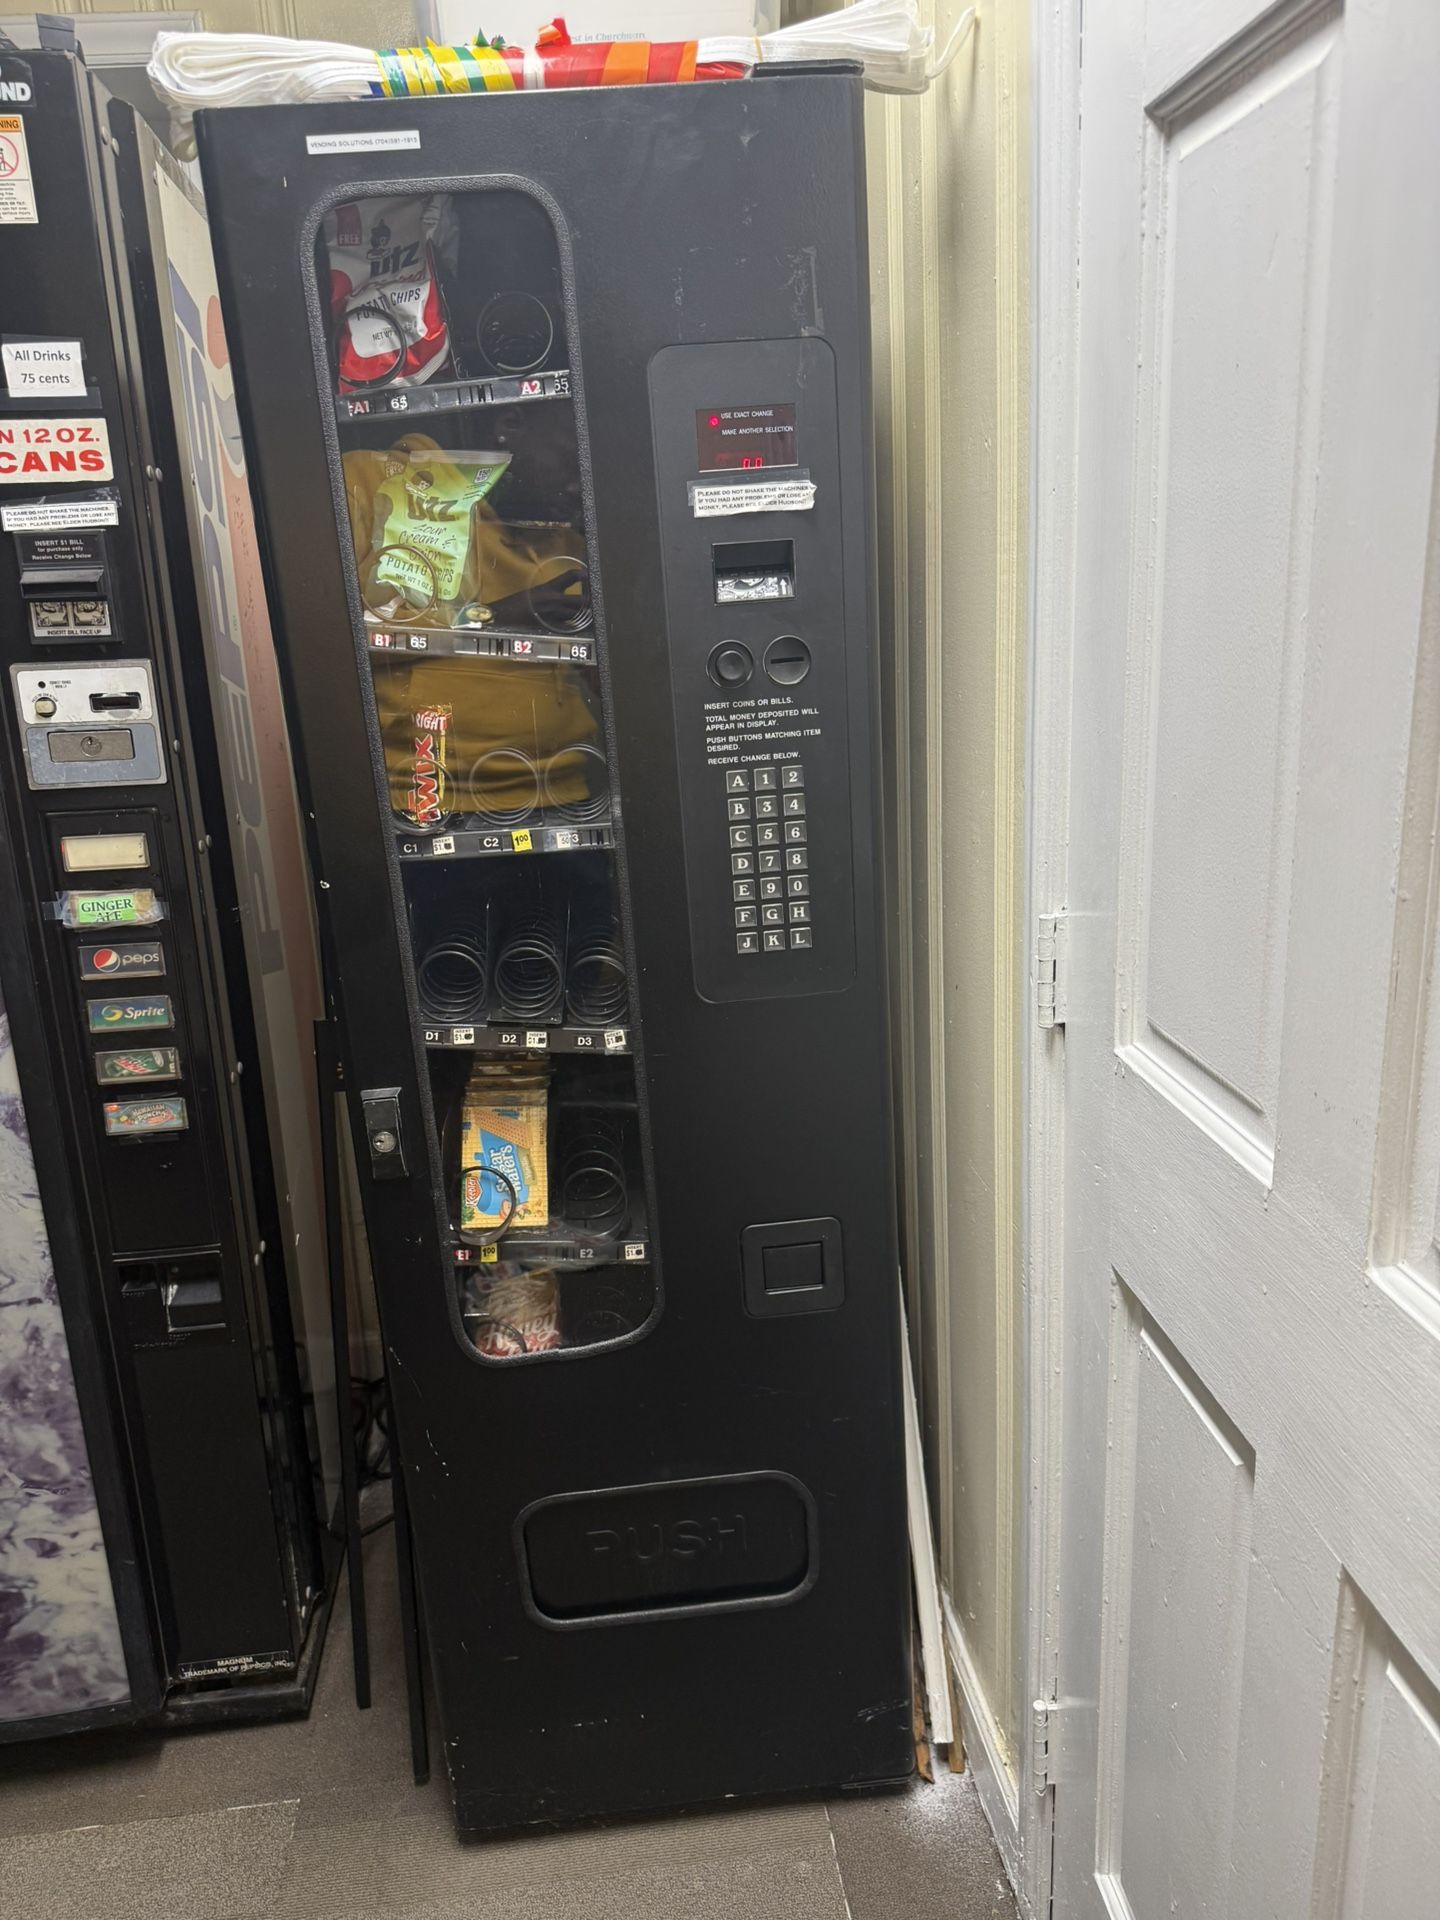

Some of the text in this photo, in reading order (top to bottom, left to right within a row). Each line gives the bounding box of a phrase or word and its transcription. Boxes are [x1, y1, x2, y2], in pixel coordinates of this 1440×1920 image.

[0, 82, 32, 101] ND
[339, 139, 374, 147] SOLUTIONS
[390, 288, 421, 306] CHIPS
[15, 350, 71, 361] All Drinks
[21, 373, 70, 384] 75 cents
[522, 380, 541, 395] A2
[23, 428, 51, 443] 12
[56, 427, 100, 443] OZ.
[739, 427, 763, 435] ANOTHER
[765, 425, 794, 433] SELECTION
[0, 449, 105, 473] CANS
[697, 489, 721, 497] PLEASE
[399, 531, 440, 546] Cream
[386, 556, 428, 577] POTATO
[375, 635, 390, 647] B1
[410, 636, 427, 648] 65
[514, 641, 532, 653] B2
[572, 647, 587, 658] 65
[704, 702, 730, 710] INSERT
[732, 700, 755, 708] COINS
[705, 715, 728, 723] TOTAL
[729, 713, 756, 721] MONEY
[758, 709, 799, 719] DEPOSITED
[706, 723, 735, 731] APPEAR
[747, 720, 779, 728] DISPLAY.
[728, 734, 763, 743] BUTTONS
[765, 730, 801, 739] MATCHING
[707, 744, 741, 752] DESIRED.
[708, 751, 801, 765] RECEIVE CHANGE BELOW.
[733, 776, 744, 787] A
[762, 774, 769, 784] 1
[789, 771, 798, 782] 2
[734, 804, 745, 815] B
[763, 801, 772, 812] 3
[790, 799, 799, 810] 4
[735, 831, 746, 842] C
[764, 829, 773, 840] 5
[791, 827, 800, 838] 6
[404, 844, 418, 852] C1
[484, 838, 499, 847] C2
[737, 858, 748, 869] D
[766, 856, 774, 867] 7
[793, 854, 801, 865] 8
[739, 885, 750, 896] E
[767, 883, 776, 893] 9
[81, 899, 133, 912] GINGER
[740, 911, 751, 922] F
[766, 909, 778, 920] G
[793, 906, 805, 918] H
[743, 937, 751, 948] J
[769, 935, 779, 946] K
[795, 933, 805, 944] L
[124, 1007, 165, 1020] Sprite
[426, 1032, 438, 1041] D1
[502, 1035, 516, 1043] D2
[577, 1037, 592, 1046] D3
[466, 1177, 479, 1207] Keebler
[457, 1249, 469, 1260] E1
[580, 1249, 594, 1258] E2
[585, 1514, 748, 1560] PUSH
[217, 1656, 253, 1667] MAGNUM
[184, 1666, 228, 1678] TRADEMARK
[229, 1665, 239, 1673] OF
